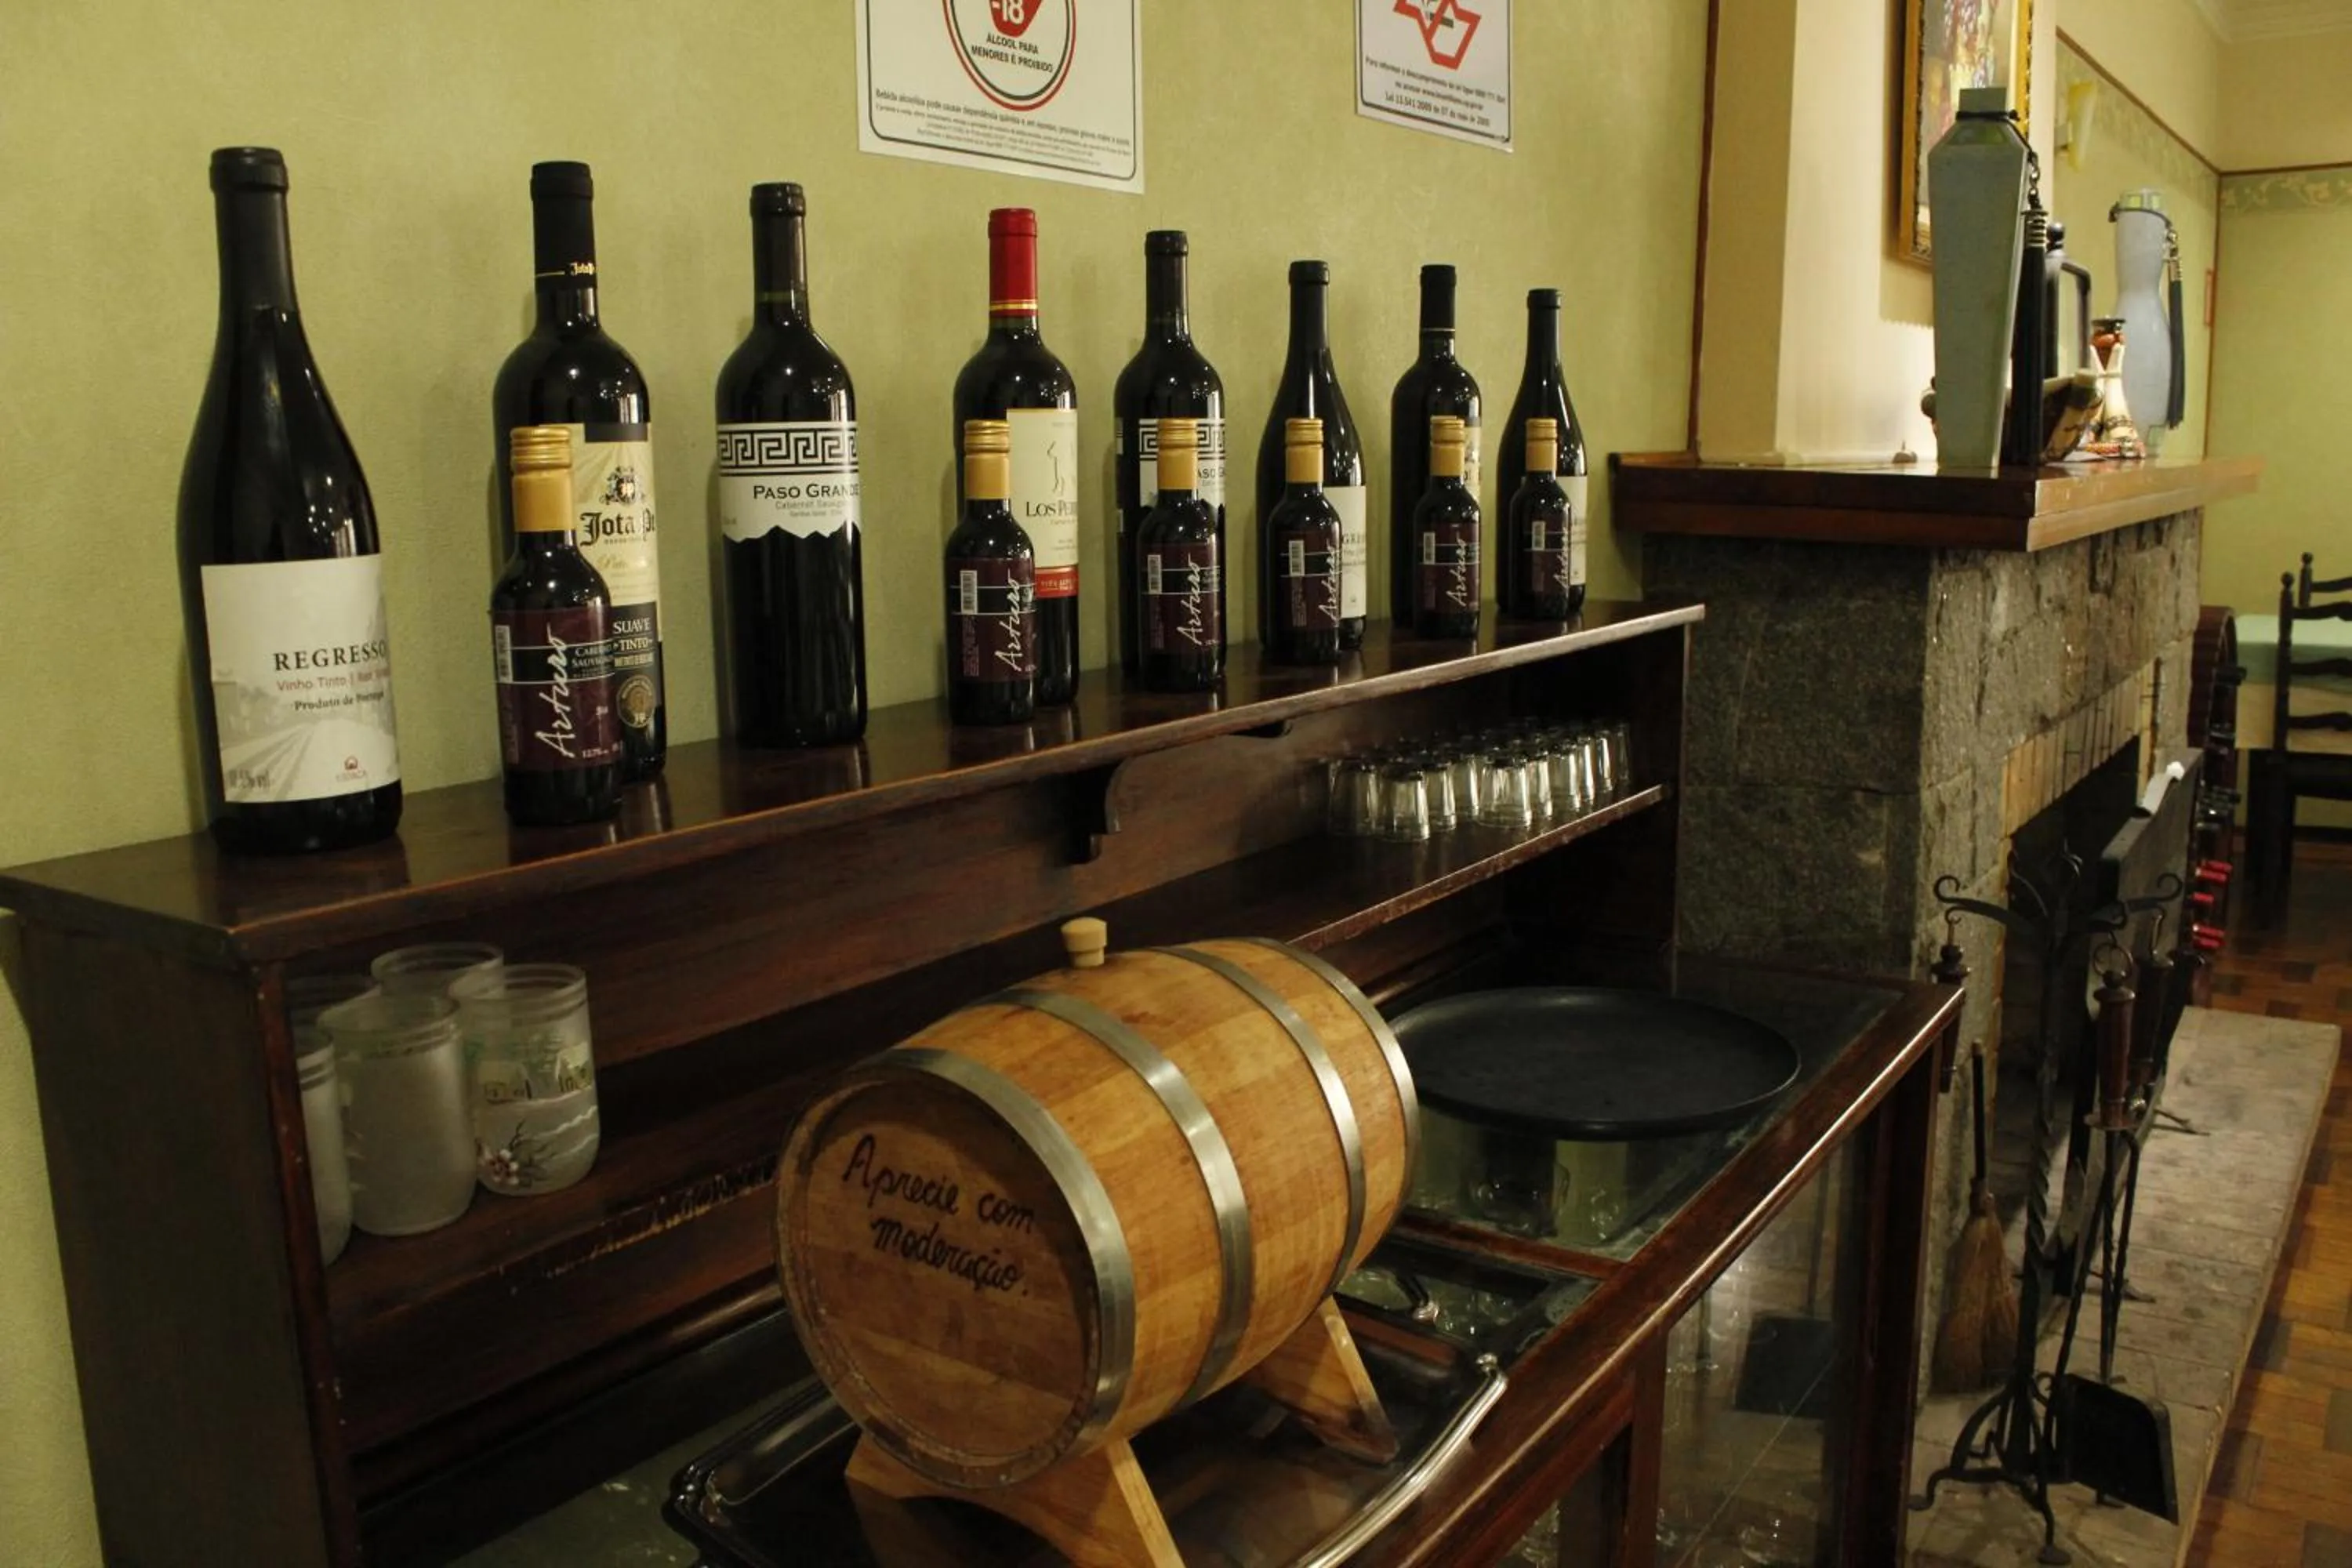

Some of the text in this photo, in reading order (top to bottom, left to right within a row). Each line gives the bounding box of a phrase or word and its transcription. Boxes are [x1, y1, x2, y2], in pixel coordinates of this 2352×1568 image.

[1018, 41, 1039, 54] PARA
[971, 45, 1009, 63] MENORES
[1018, 56, 1054, 73] PROIBIDO
[753, 485, 800, 499] PASO
[1026, 501, 1056, 517] LOS
[579, 512, 635, 546] Jota
[612, 617, 651, 634] SUAVE
[994, 568, 1023, 672] Arturo
[619, 637, 649, 651] TINTO
[273, 639, 387, 672] REGRESSO
[276, 678, 314, 691] Vinho
[317, 676, 347, 689] Tinto
[534, 622, 575, 759] Arturo
[294, 697, 339, 711] Produto
[842, 1133, 1035, 1234] Aprecie com
